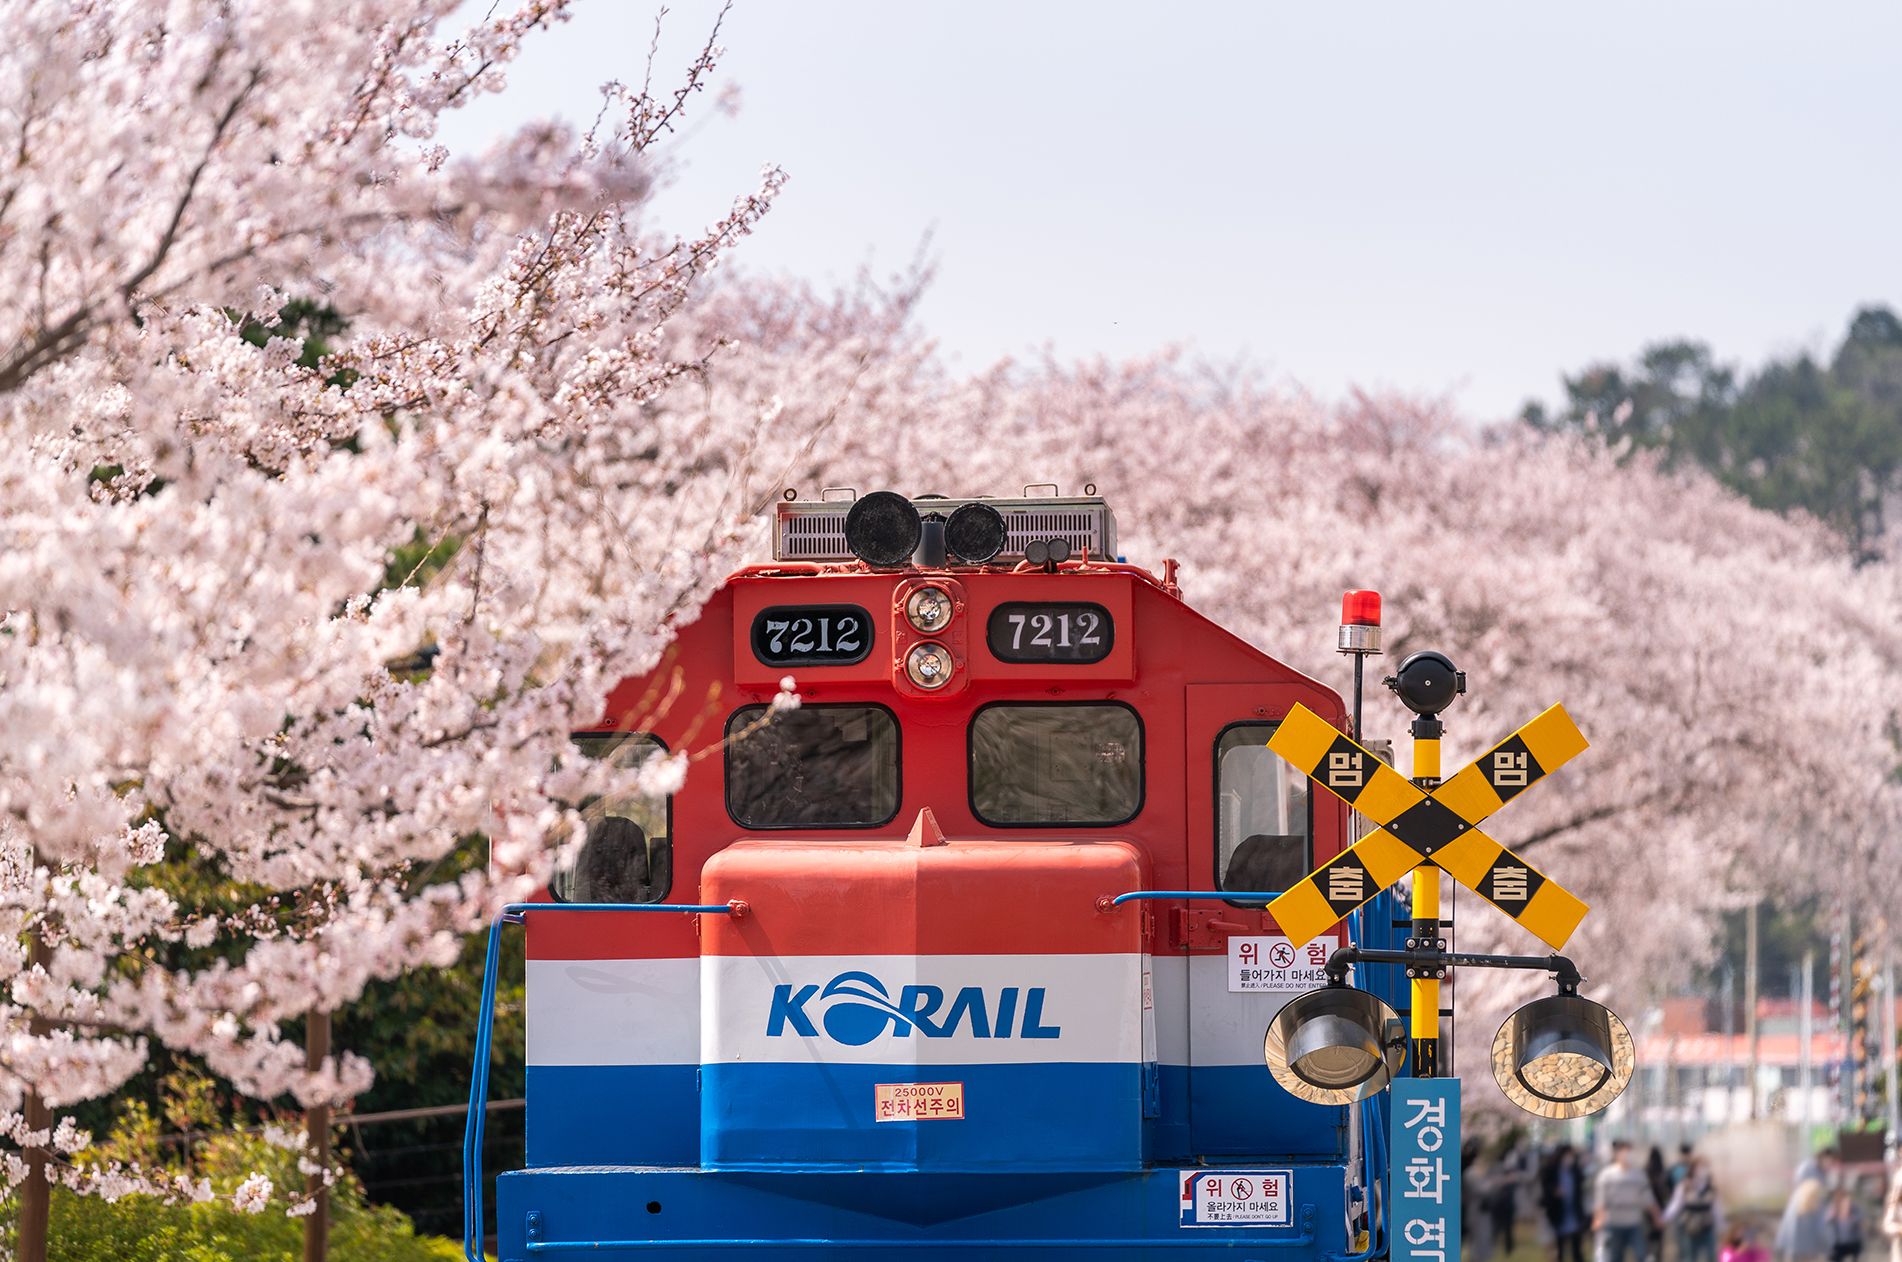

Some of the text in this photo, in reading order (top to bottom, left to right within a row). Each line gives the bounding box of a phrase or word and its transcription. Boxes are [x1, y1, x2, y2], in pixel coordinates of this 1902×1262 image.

[766, 618, 860, 653] 7212
[1008, 613, 1101, 650] 7212
[1329, 752, 1362, 786] 멈
[1493, 752, 1527, 786] 멈
[1329, 866, 1363, 901] 춤
[1493, 866, 1527, 901] 춤
[1239, 943, 1326, 965] 위 험
[1240, 969, 1327, 981] 들어가지 마세요
[766, 971, 1061, 1046] KORAIL
[881, 1097, 960, 1117] 전차선주의
[894, 1086, 944, 1098] 25000V
[1206, 1179, 1278, 1198] 위 험
[1206, 1201, 1279, 1212] 올라가지 마세요
